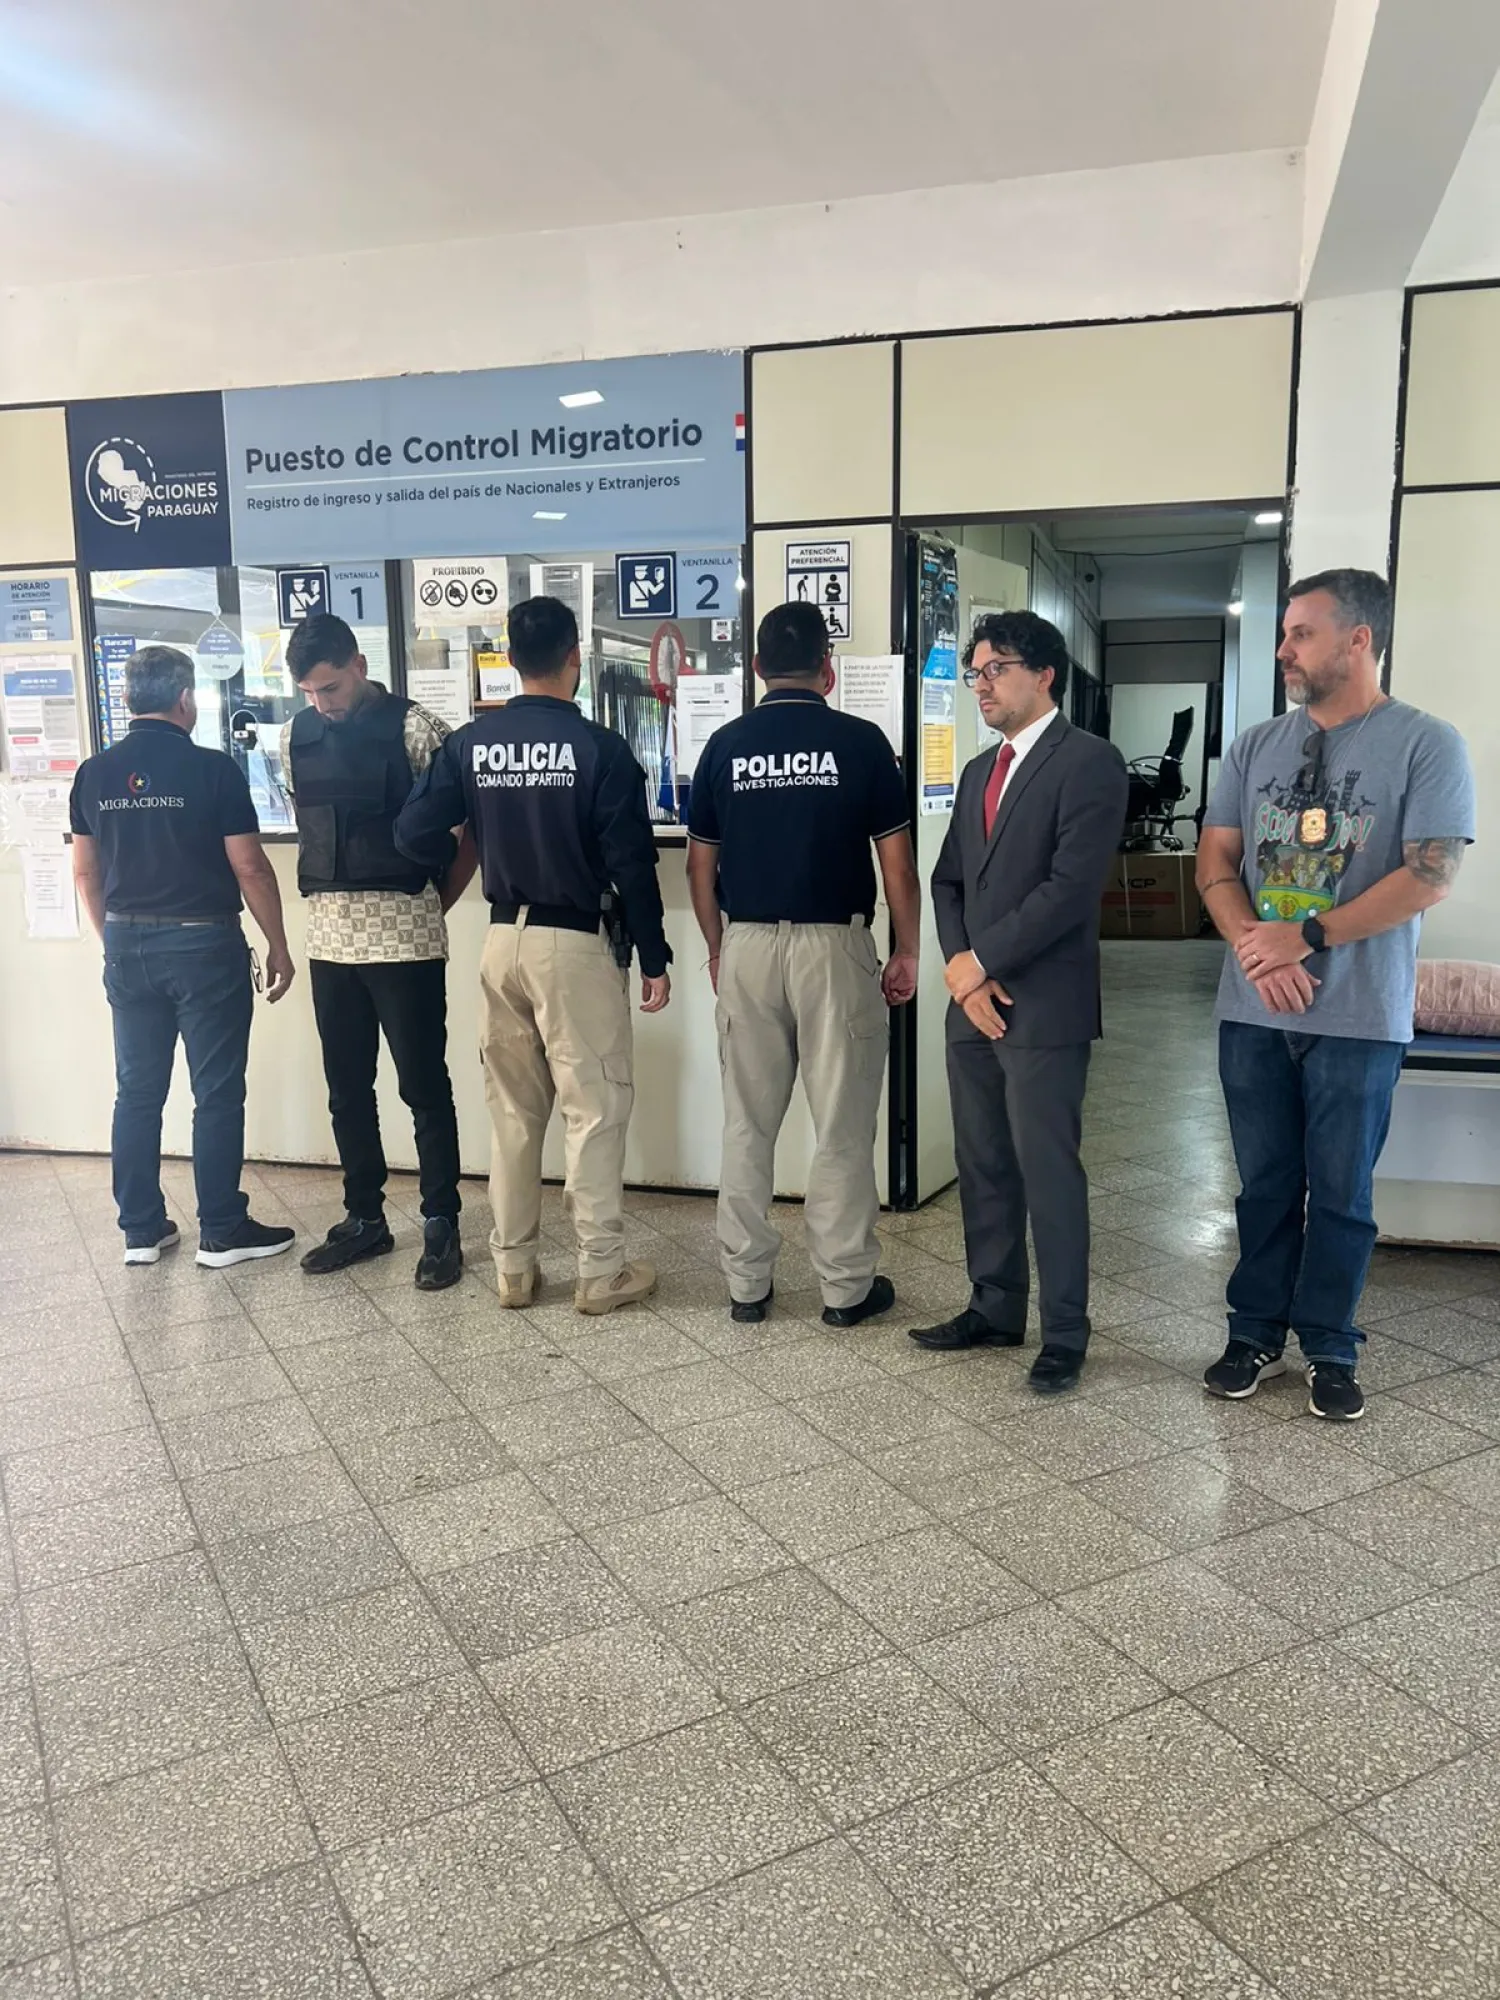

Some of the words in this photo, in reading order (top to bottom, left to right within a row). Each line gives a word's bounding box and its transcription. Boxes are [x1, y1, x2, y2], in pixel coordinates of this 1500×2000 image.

[246, 445, 345, 474] Puesto
[354, 440, 392, 466] de
[403, 430, 519, 464] Control
[531, 418, 703, 459] Migratorio
[100, 481, 218, 502] MIGRACIONES
[247, 495, 300, 511] Registro
[303, 493, 320, 506] de
[323, 490, 371, 507] ingreso
[374, 491, 382, 505] y
[386, 486, 425, 502] salida
[428, 485, 450, 500] del
[453, 481, 481, 500] país
[484, 482, 502, 497] de
[506, 479, 582, 496] Nacionales
[586, 480, 594, 494] y
[599, 474, 681, 490] Extranjeros
[147, 501, 219, 517] PARAGUAY
[800, 547, 837, 556] ATENCIÓN
[681, 557, 734, 567] VENTANILLA
[791, 556, 845, 564] PREFERENCIAL
[334, 571, 380, 580] VENTANILLA
[432, 565, 485, 576] PROHIBIDO
[10, 581, 51, 591] HORARIO
[696, 573, 720, 610] 2
[350, 586, 364, 620] 1
[472, 742, 577, 772] POLICIA
[732, 751, 839, 781] POLICIA
[475, 773, 523, 788] COMANDO
[733, 775, 839, 792] INVESTIGACIONES
[98, 796, 185, 811] MIGRACIONES
